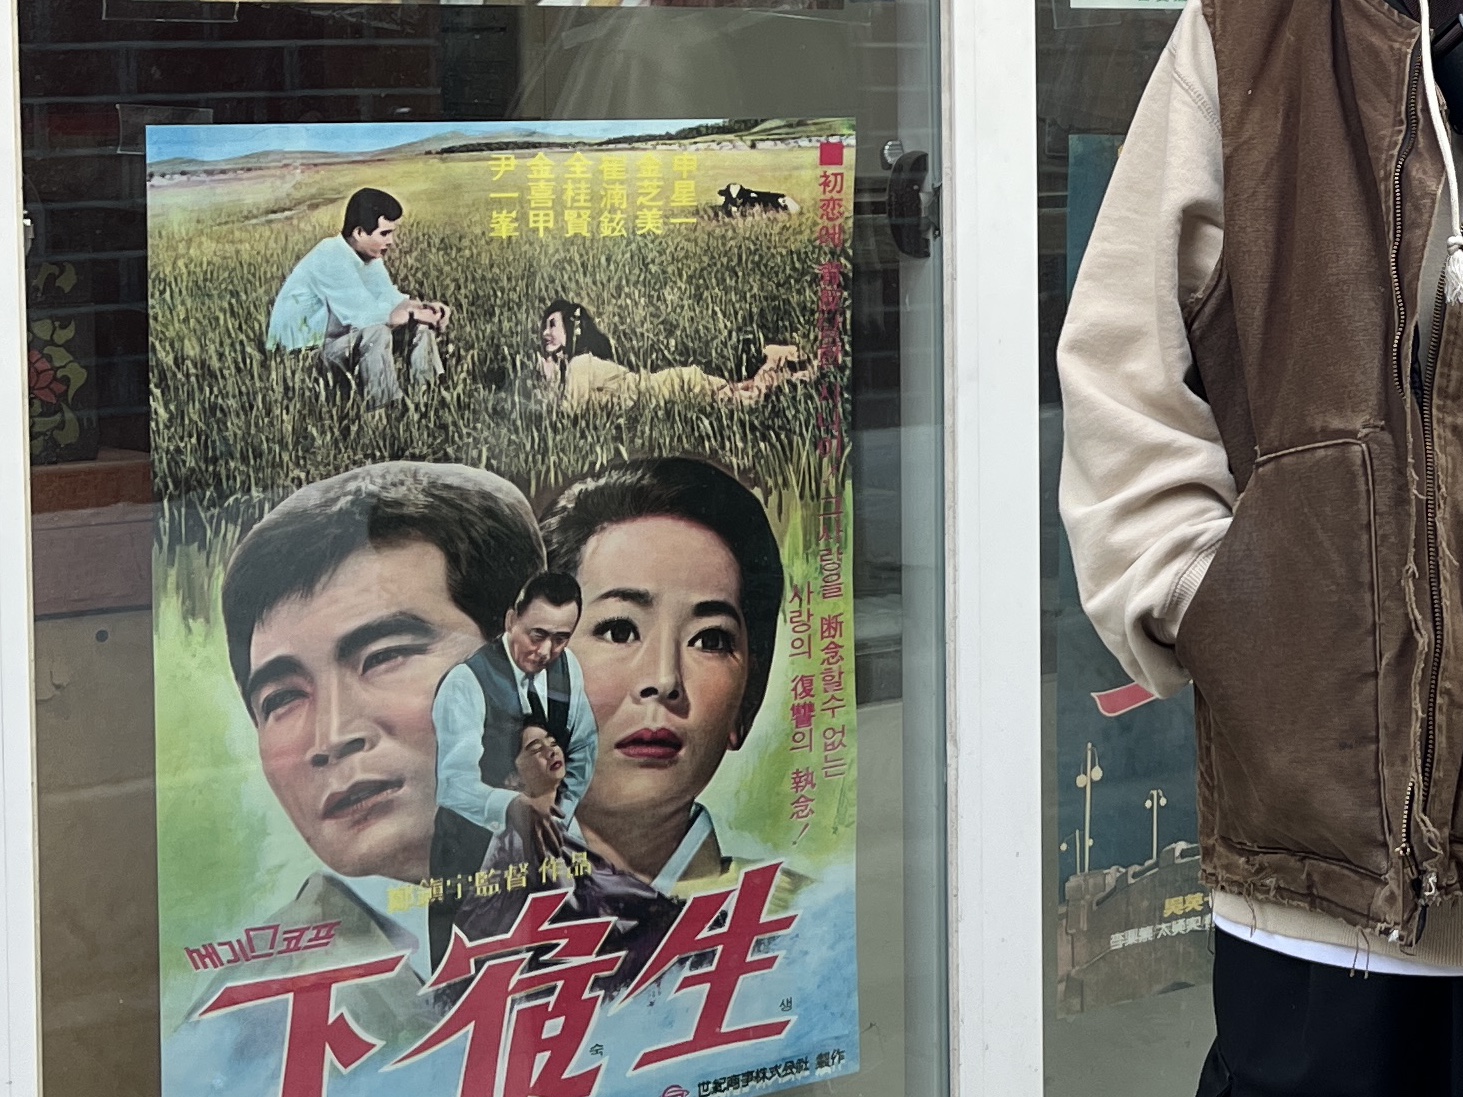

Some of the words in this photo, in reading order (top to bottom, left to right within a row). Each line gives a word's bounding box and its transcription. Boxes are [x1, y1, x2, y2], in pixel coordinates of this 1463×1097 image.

[526, 152, 555, 238] 金喜甲
[563, 152, 593, 238] 全桂賢
[635, 152, 664, 236] 金芝美
[670, 152, 698, 225] 申星一
[789, 581, 814, 660] 사랑의
